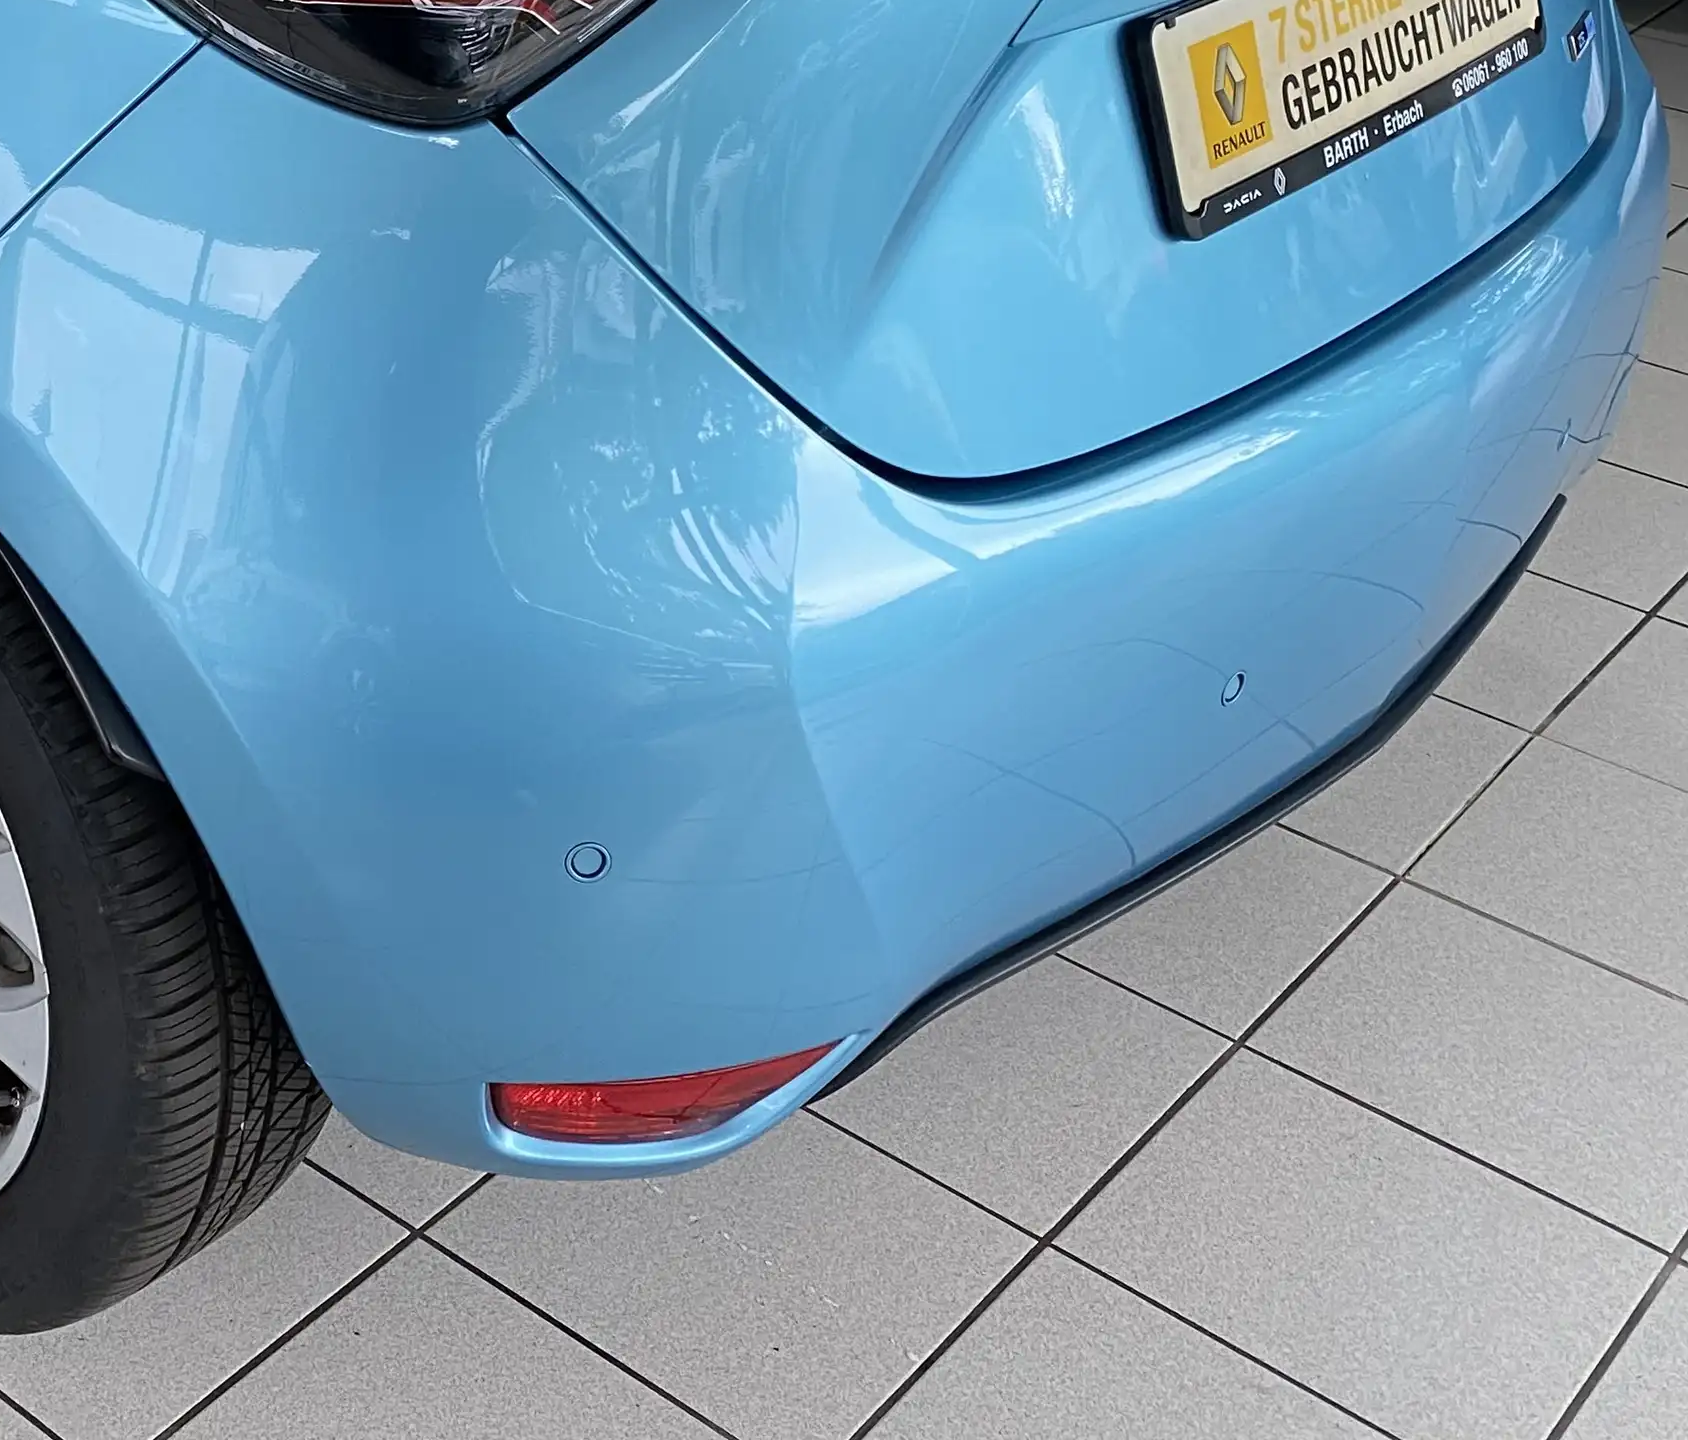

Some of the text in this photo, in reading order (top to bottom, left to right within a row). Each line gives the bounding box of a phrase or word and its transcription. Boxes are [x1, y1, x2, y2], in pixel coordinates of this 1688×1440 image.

[1269, 6, 1287, 63] 7
[1323, 129, 1369, 168] BARTH
[1383, 102, 1424, 137] Erbach
[1462, 60, 1490, 92] 06061
[1512, 38, 1529, 62] 100
[1213, 121, 1266, 160] RENAULT
[1223, 189, 1262, 214] DACIA
